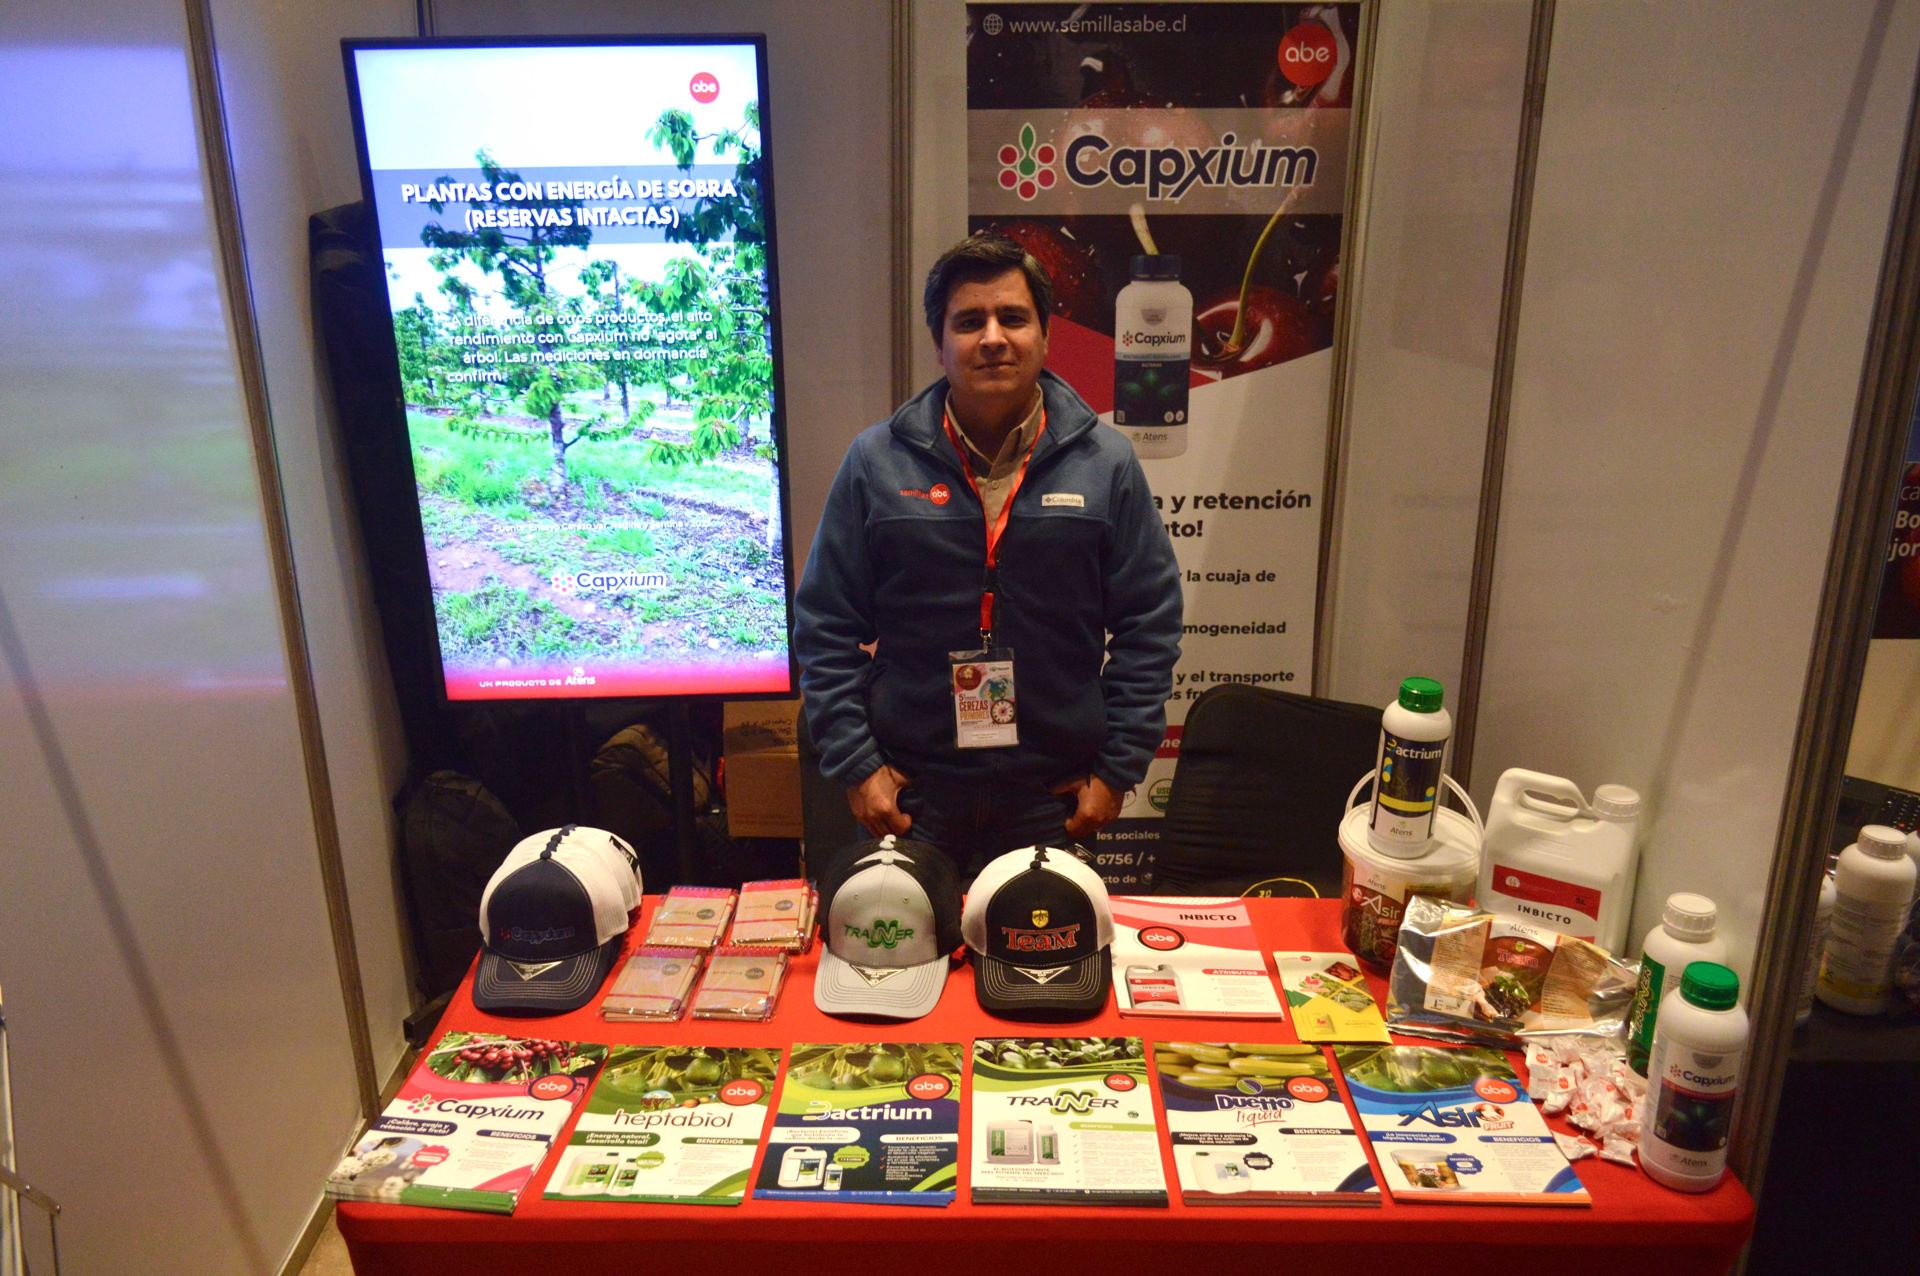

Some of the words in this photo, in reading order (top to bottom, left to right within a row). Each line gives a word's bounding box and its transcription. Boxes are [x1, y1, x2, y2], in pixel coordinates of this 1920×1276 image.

[1009, 14, 1187, 33] www.semillasabe.cl
[1285, 42, 1330, 63] abe
[692, 80, 717, 94] abe
[1064, 131, 1318, 200] Capxium
[401, 182, 492, 203] PLANTAS
[496, 182, 543, 200] CON
[547, 176, 634, 200] ENERGÍA
[637, 181, 664, 199] DE
[667, 179, 737, 199] SOBRA
[465, 208, 573, 232] (RESERVAS
[577, 206, 679, 229] INTACTAS)
[536, 314, 553, 325] de
[557, 314, 592, 325] otros
[671, 311, 684, 322] el
[687, 311, 712, 322] alto
[450, 332, 535, 346] rendimiento
[538, 333, 563, 344] con
[568, 331, 630, 346] Capxium
[632, 332, 650, 342] no
[705, 330, 718, 341] al
[1135, 332, 1185, 346] Capxium
[463, 351, 501, 364] árbol.
[504, 351, 527, 363] Las
[531, 348, 610, 362] mediciones
[613, 350, 630, 360] en
[1143, 432, 1168, 441] Atens
[1171, 496, 1186, 514] y
[1194, 490, 1311, 510] retención
[1888, 537, 1920, 562] jor
[576, 572, 665, 590] Capxium
[1187, 570, 1201, 582] la
[1206, 569, 1250, 585] cuaja
[1256, 570, 1276, 582] de
[1183, 622, 1286, 637] mogeneidad
[495, 679, 546, 687] PRODUCTO
[549, 679, 562, 687] DE
[565, 674, 595, 687] Atens
[1176, 672, 1186, 685] y
[1190, 671, 1204, 682] el
[1209, 671, 1294, 685] transporte
[959, 701, 989, 712] CEREZAS
[1386, 739, 1442, 760] Bactrium
[1115, 831, 1160, 840] sociales
[1391, 826, 1413, 836] Atens
[1097, 854, 1133, 865] 6756
[1120, 874, 1137, 883] de
[1360, 895, 1400, 919] Asir
[1518, 904, 1571, 925] INBICTO
[845, 919, 914, 949] TRAINER
[1146, 933, 1175, 943] abe
[1633, 967, 1652, 1034] TRAINER
[914, 1080, 944, 1091] abe
[1110, 1078, 1130, 1086] abe
[1683, 1070, 1735, 1087] Capxium
[538, 1081, 567, 1092] abe
[726, 1085, 756, 1096] abe
[1293, 1083, 1323, 1094] abe
[1480, 1084, 1511, 1095] abe
[1007, 1088, 1119, 1115] TRAINER
[437, 1100, 544, 1120] Capxium
[803, 1101, 932, 1121] Bactrium
[1398, 1101, 1481, 1128] Asir
[614, 1108, 733, 1129] heptabiol
[1484, 1121, 1514, 1131] FRUIT
[490, 1130, 536, 1140] BENEFICIOS
[1680, 1156, 1707, 1167] Atens
